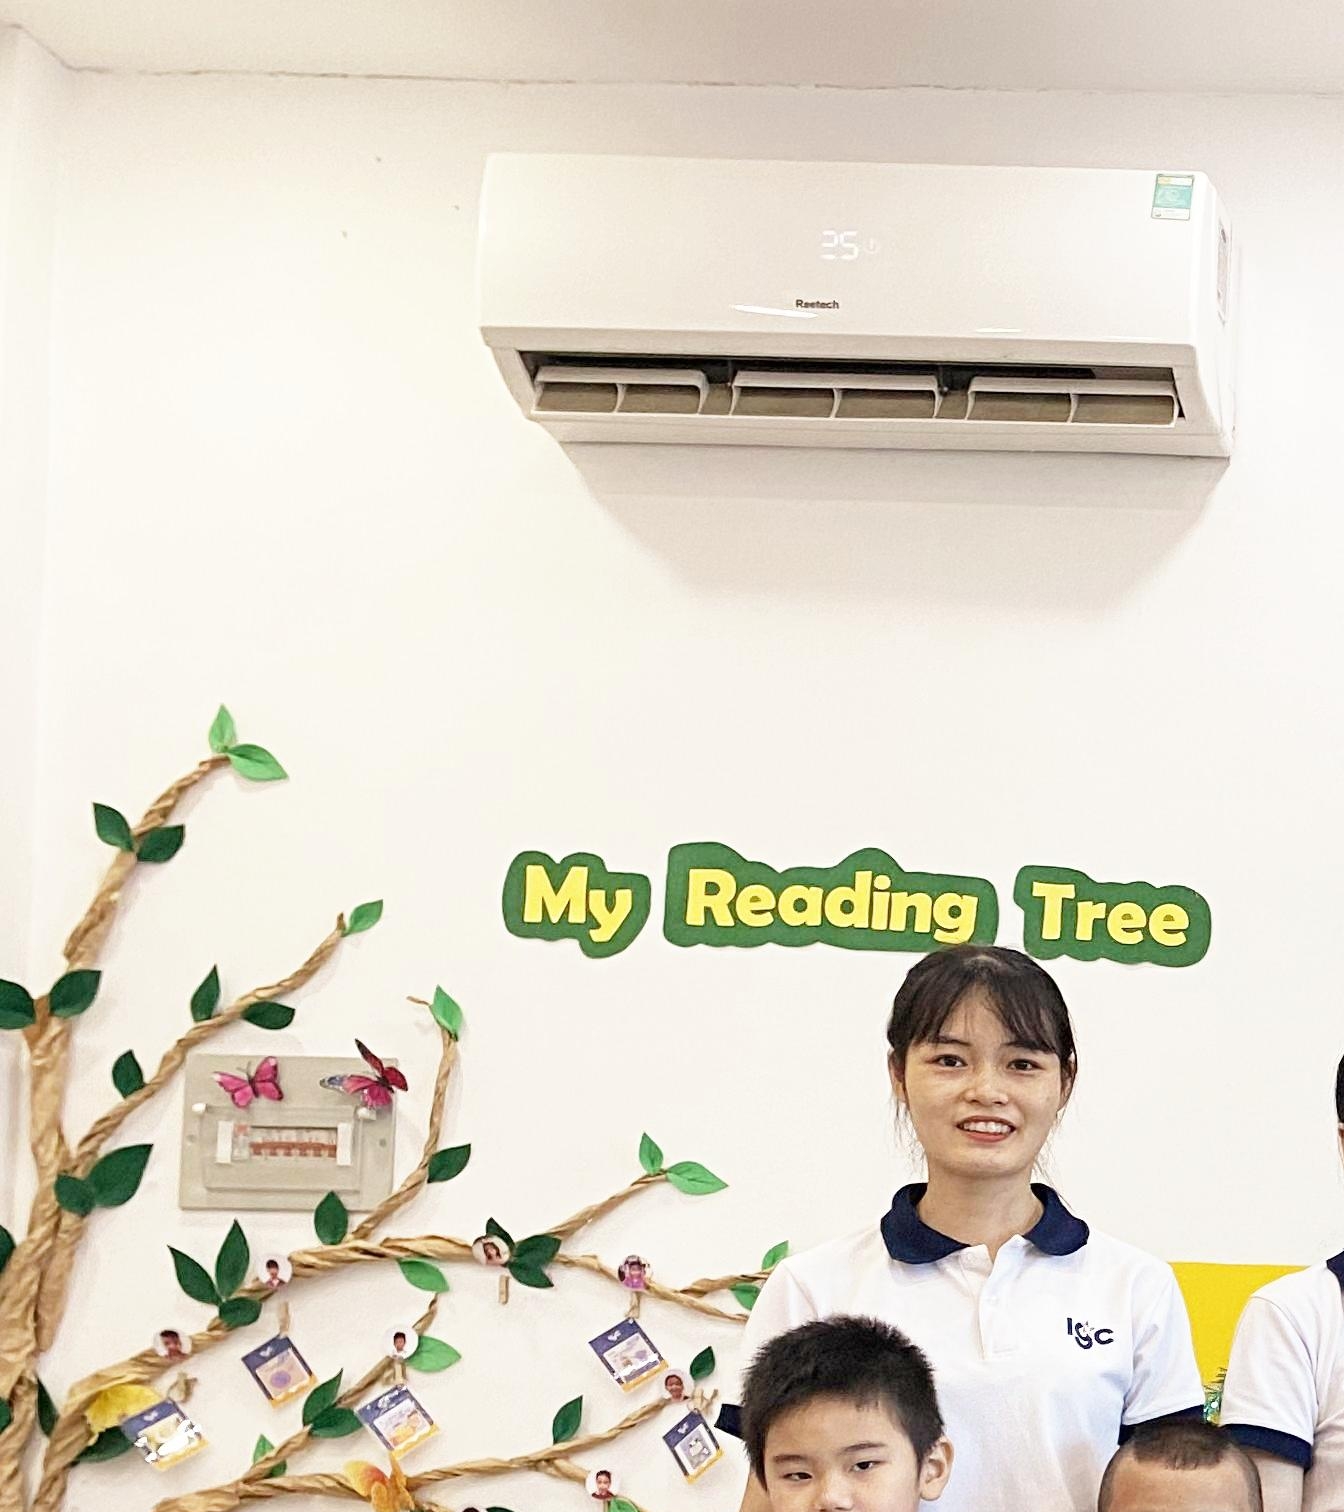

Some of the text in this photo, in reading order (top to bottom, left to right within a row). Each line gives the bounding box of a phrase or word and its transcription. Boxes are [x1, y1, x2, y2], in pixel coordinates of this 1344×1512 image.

[796, 299, 840, 309] Reetech
[523, 864, 1191, 947] My Reading Tree
